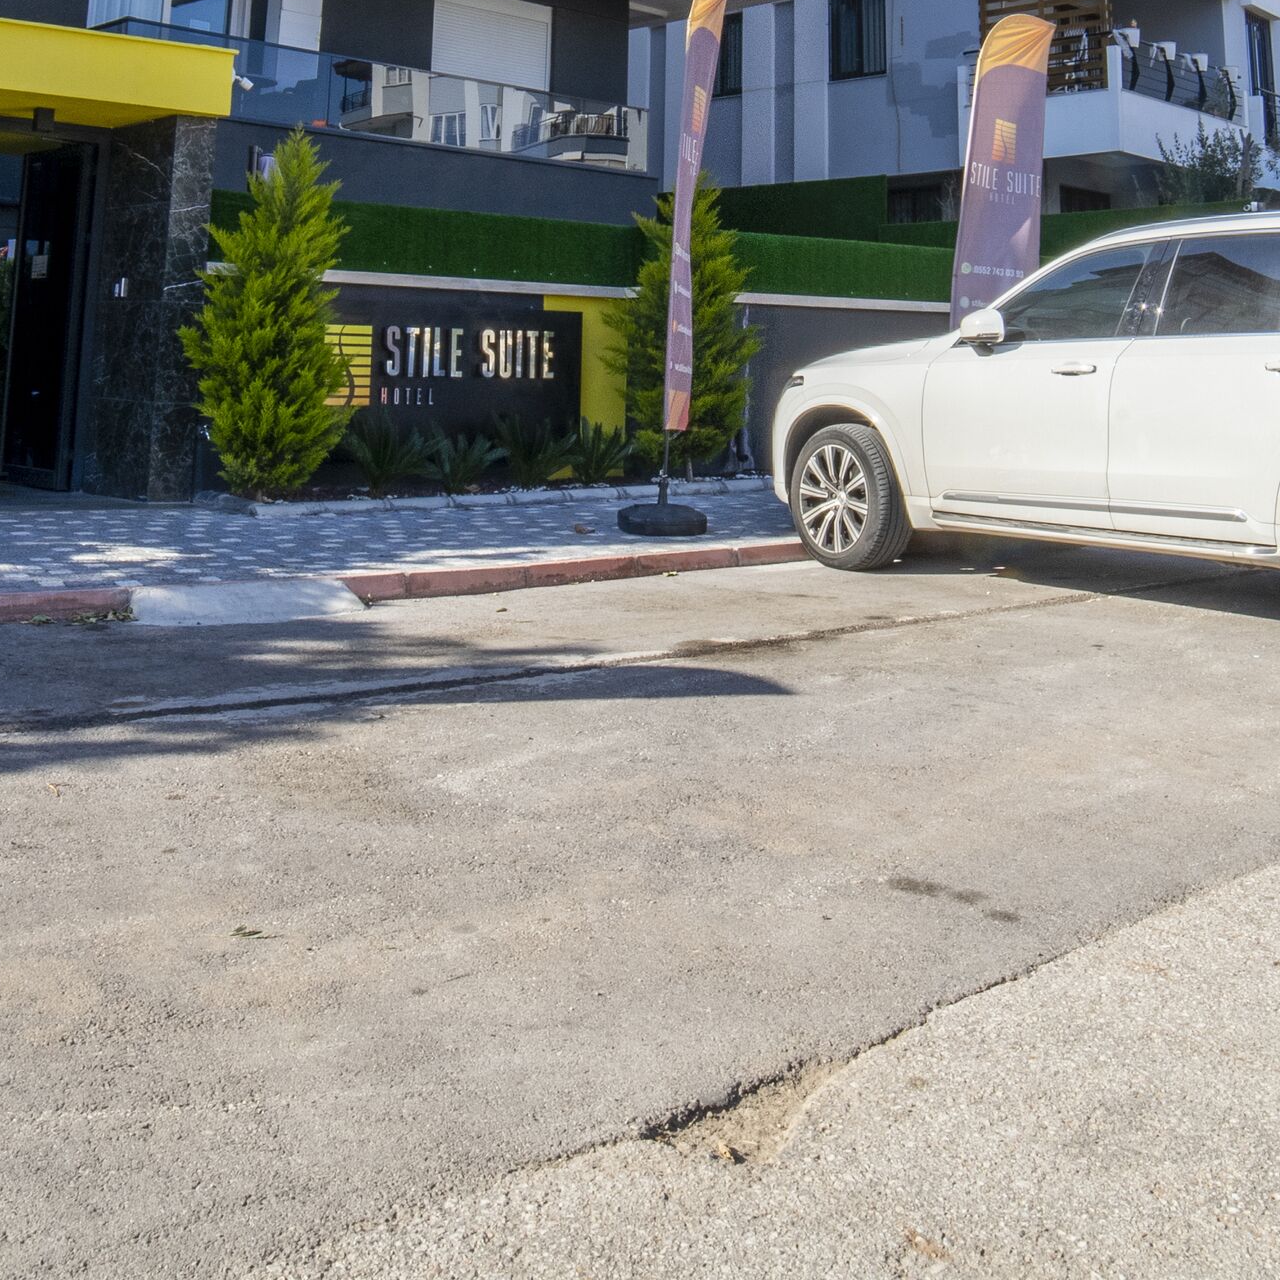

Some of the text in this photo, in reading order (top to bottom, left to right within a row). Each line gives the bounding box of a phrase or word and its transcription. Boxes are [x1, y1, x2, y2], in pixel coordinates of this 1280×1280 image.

[970, 161, 1041, 198] STILE SUITE
[989, 192, 1015, 205] HOTEL
[386, 325, 555, 379] STILE SUITE
[380, 387, 434, 405] HOTEL
